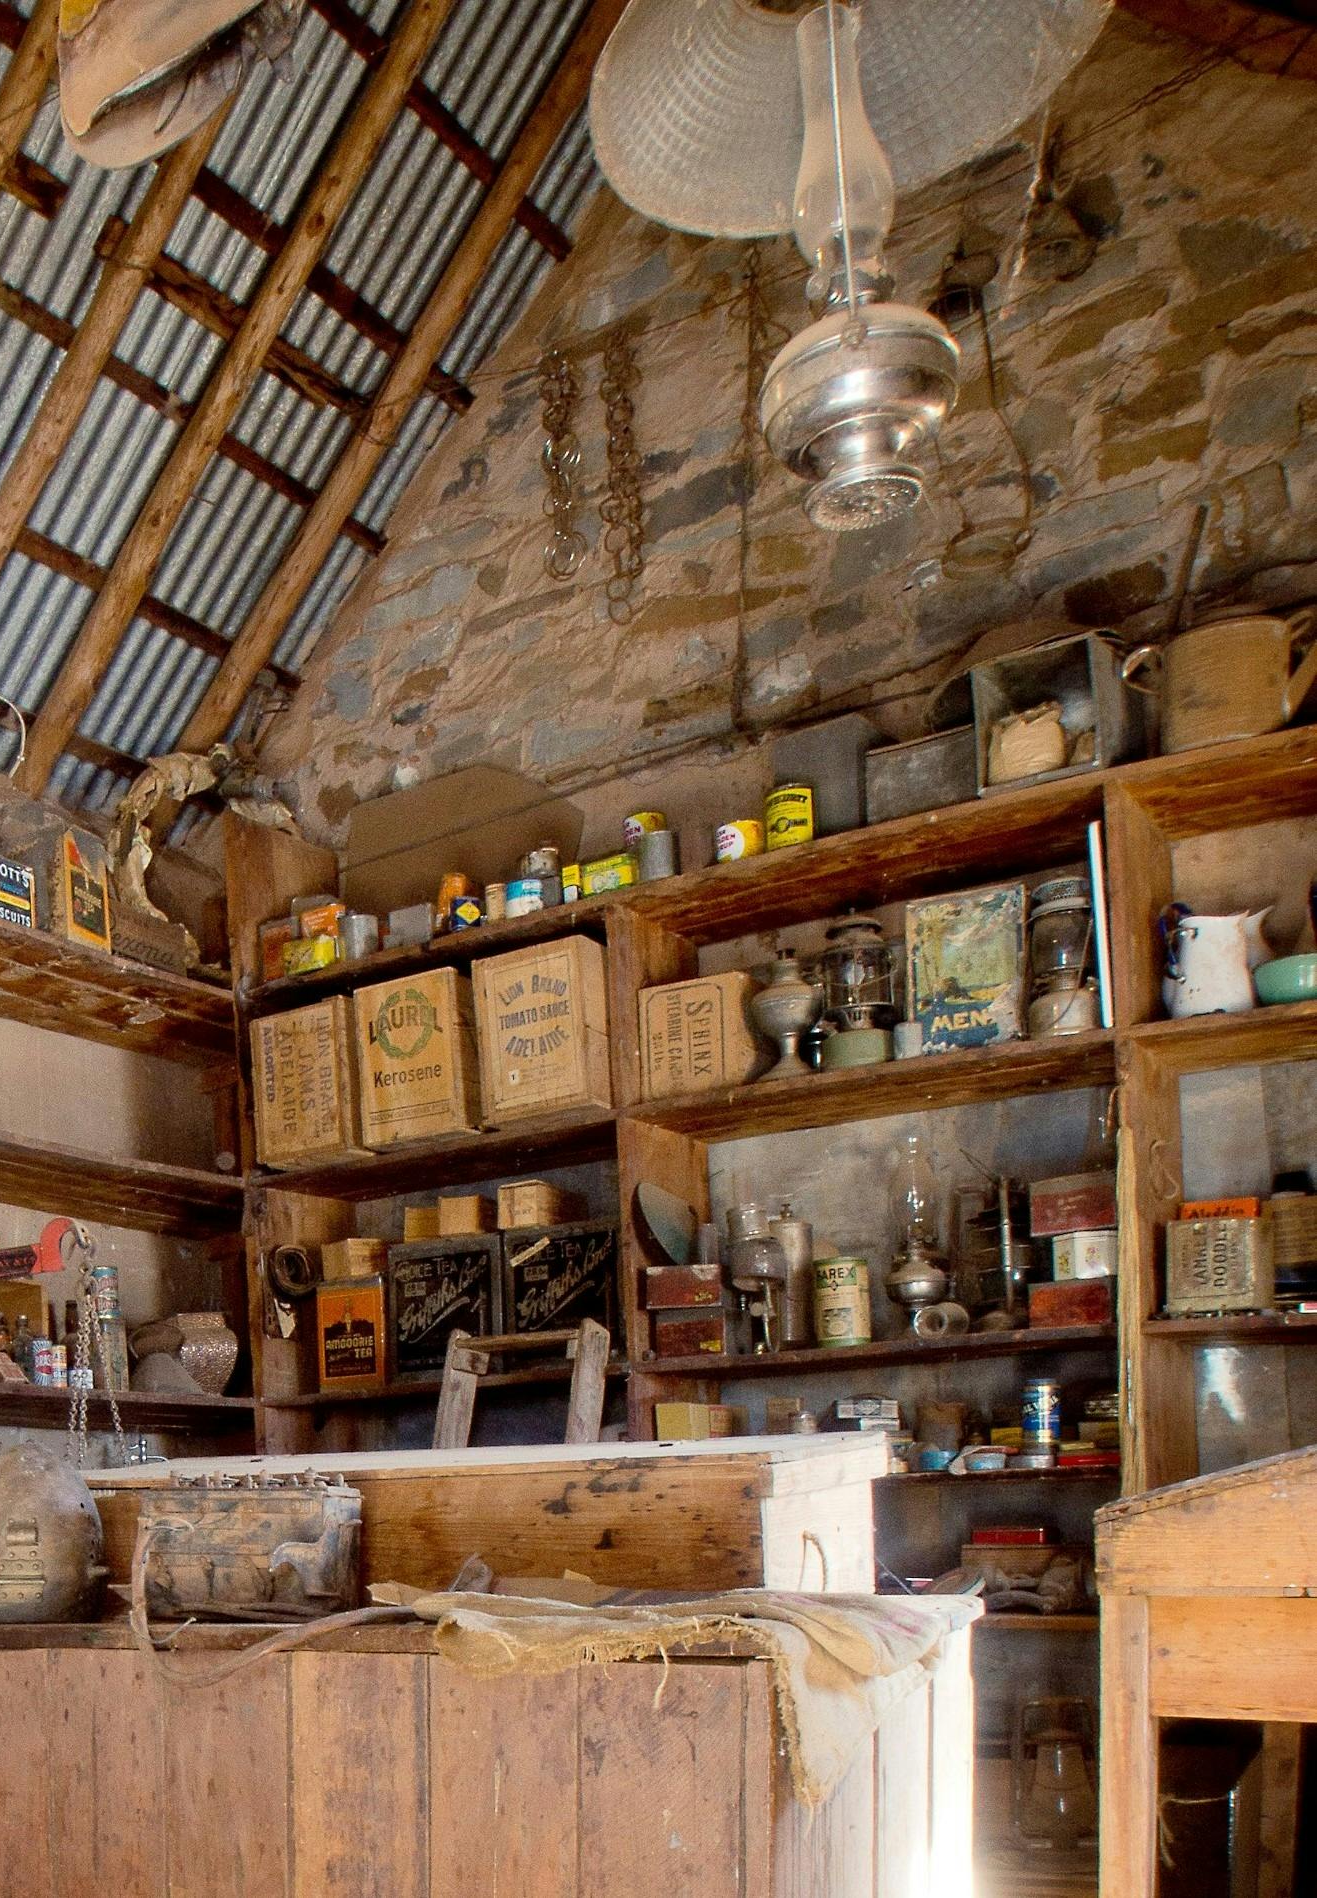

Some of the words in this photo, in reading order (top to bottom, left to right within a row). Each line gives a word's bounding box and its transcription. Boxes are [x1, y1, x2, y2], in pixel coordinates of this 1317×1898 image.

[499, 1007, 537, 1030] TOMATO
[540, 1000, 570, 1020] SAUCE
[685, 1000, 714, 1076] SPHINX
[374, 1063, 442, 1089] Kerosene
[554, 1239, 583, 1258] TEA
